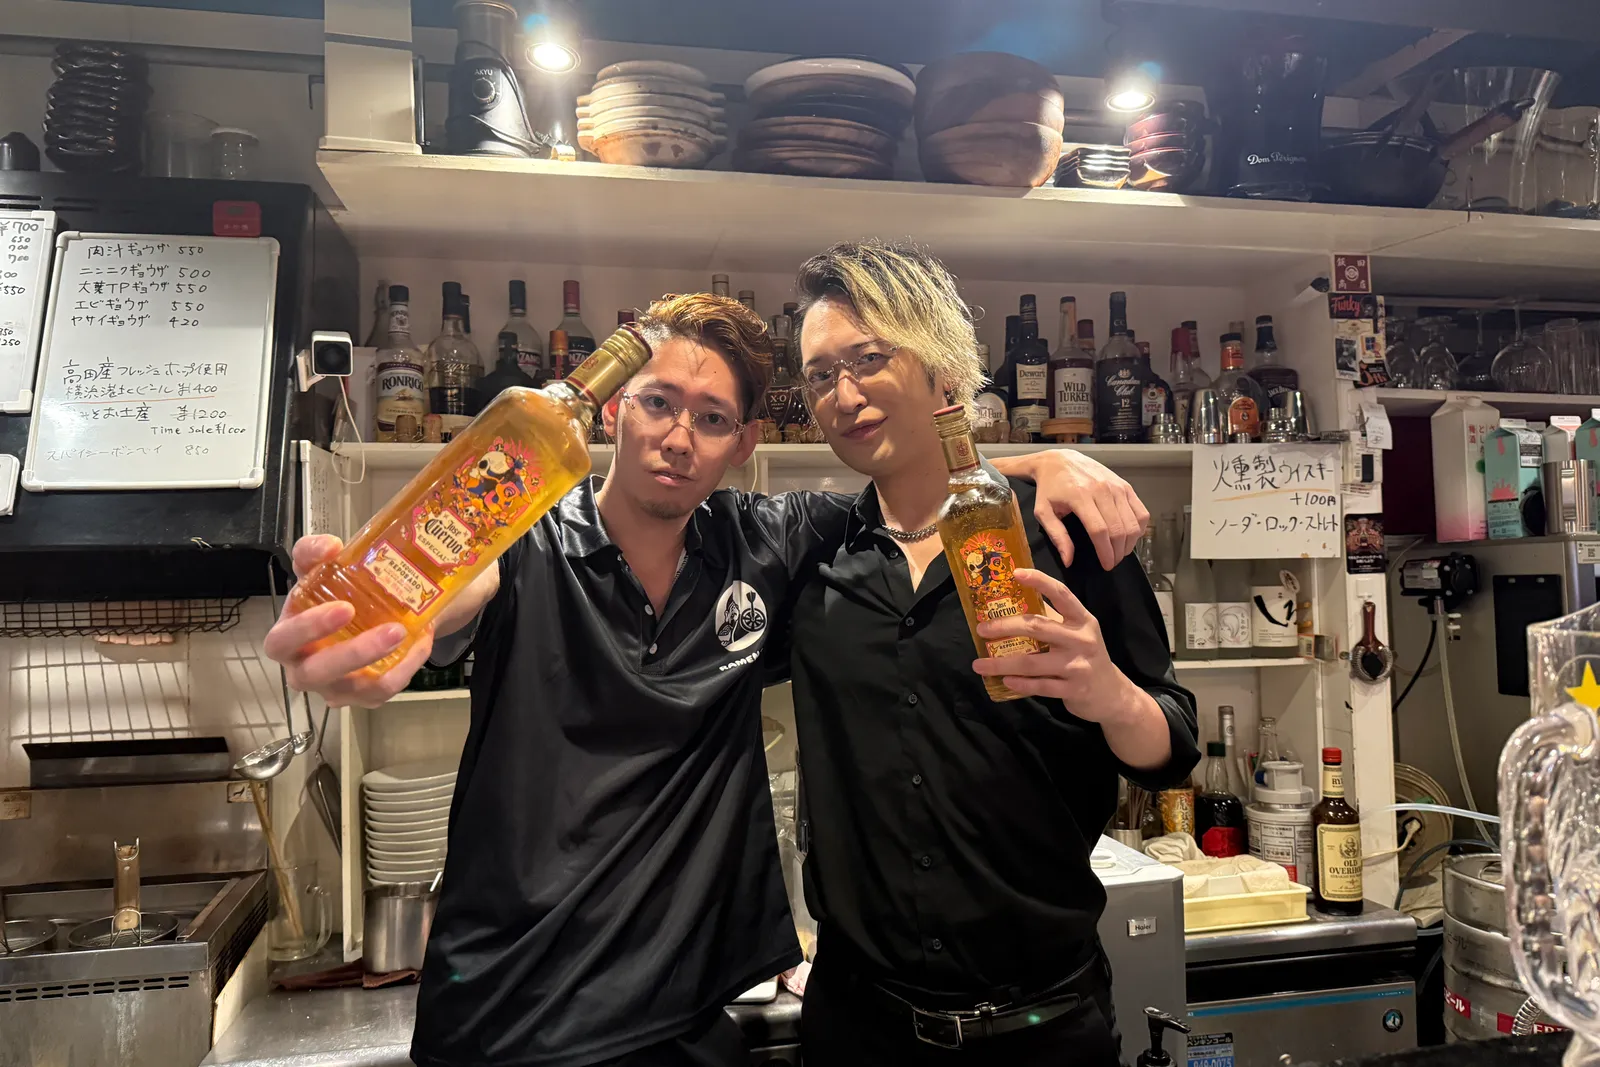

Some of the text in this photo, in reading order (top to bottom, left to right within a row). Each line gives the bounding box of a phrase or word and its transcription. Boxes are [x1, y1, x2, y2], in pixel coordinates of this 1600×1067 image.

[1247, 154, 1270, 165] Dom
[178, 246, 204, 256] 550
[178, 267, 211, 279] 500
[175, 283, 208, 294] 550
[74, 298, 205, 312] エビギョウザ 550
[71, 314, 199, 328] ヤサイギョウザ 420
[382, 375, 424, 392] RONRICO
[1063, 382, 1087, 392] WILD
[1058, 391, 1090, 402] TURKEY
[1114, 386, 1135, 396] Club
[1121, 399, 1130, 407] 12
[151, 426, 181, 435] Time
[185, 445, 209, 455] 850
[425, 519, 463, 554] Cuervo
[417, 535, 447, 561] ESPECIAL
[388, 560, 421, 590] REPOSADO
[400, 561, 420, 579] TEQUILA
[988, 606, 1017, 619] Cuervo
